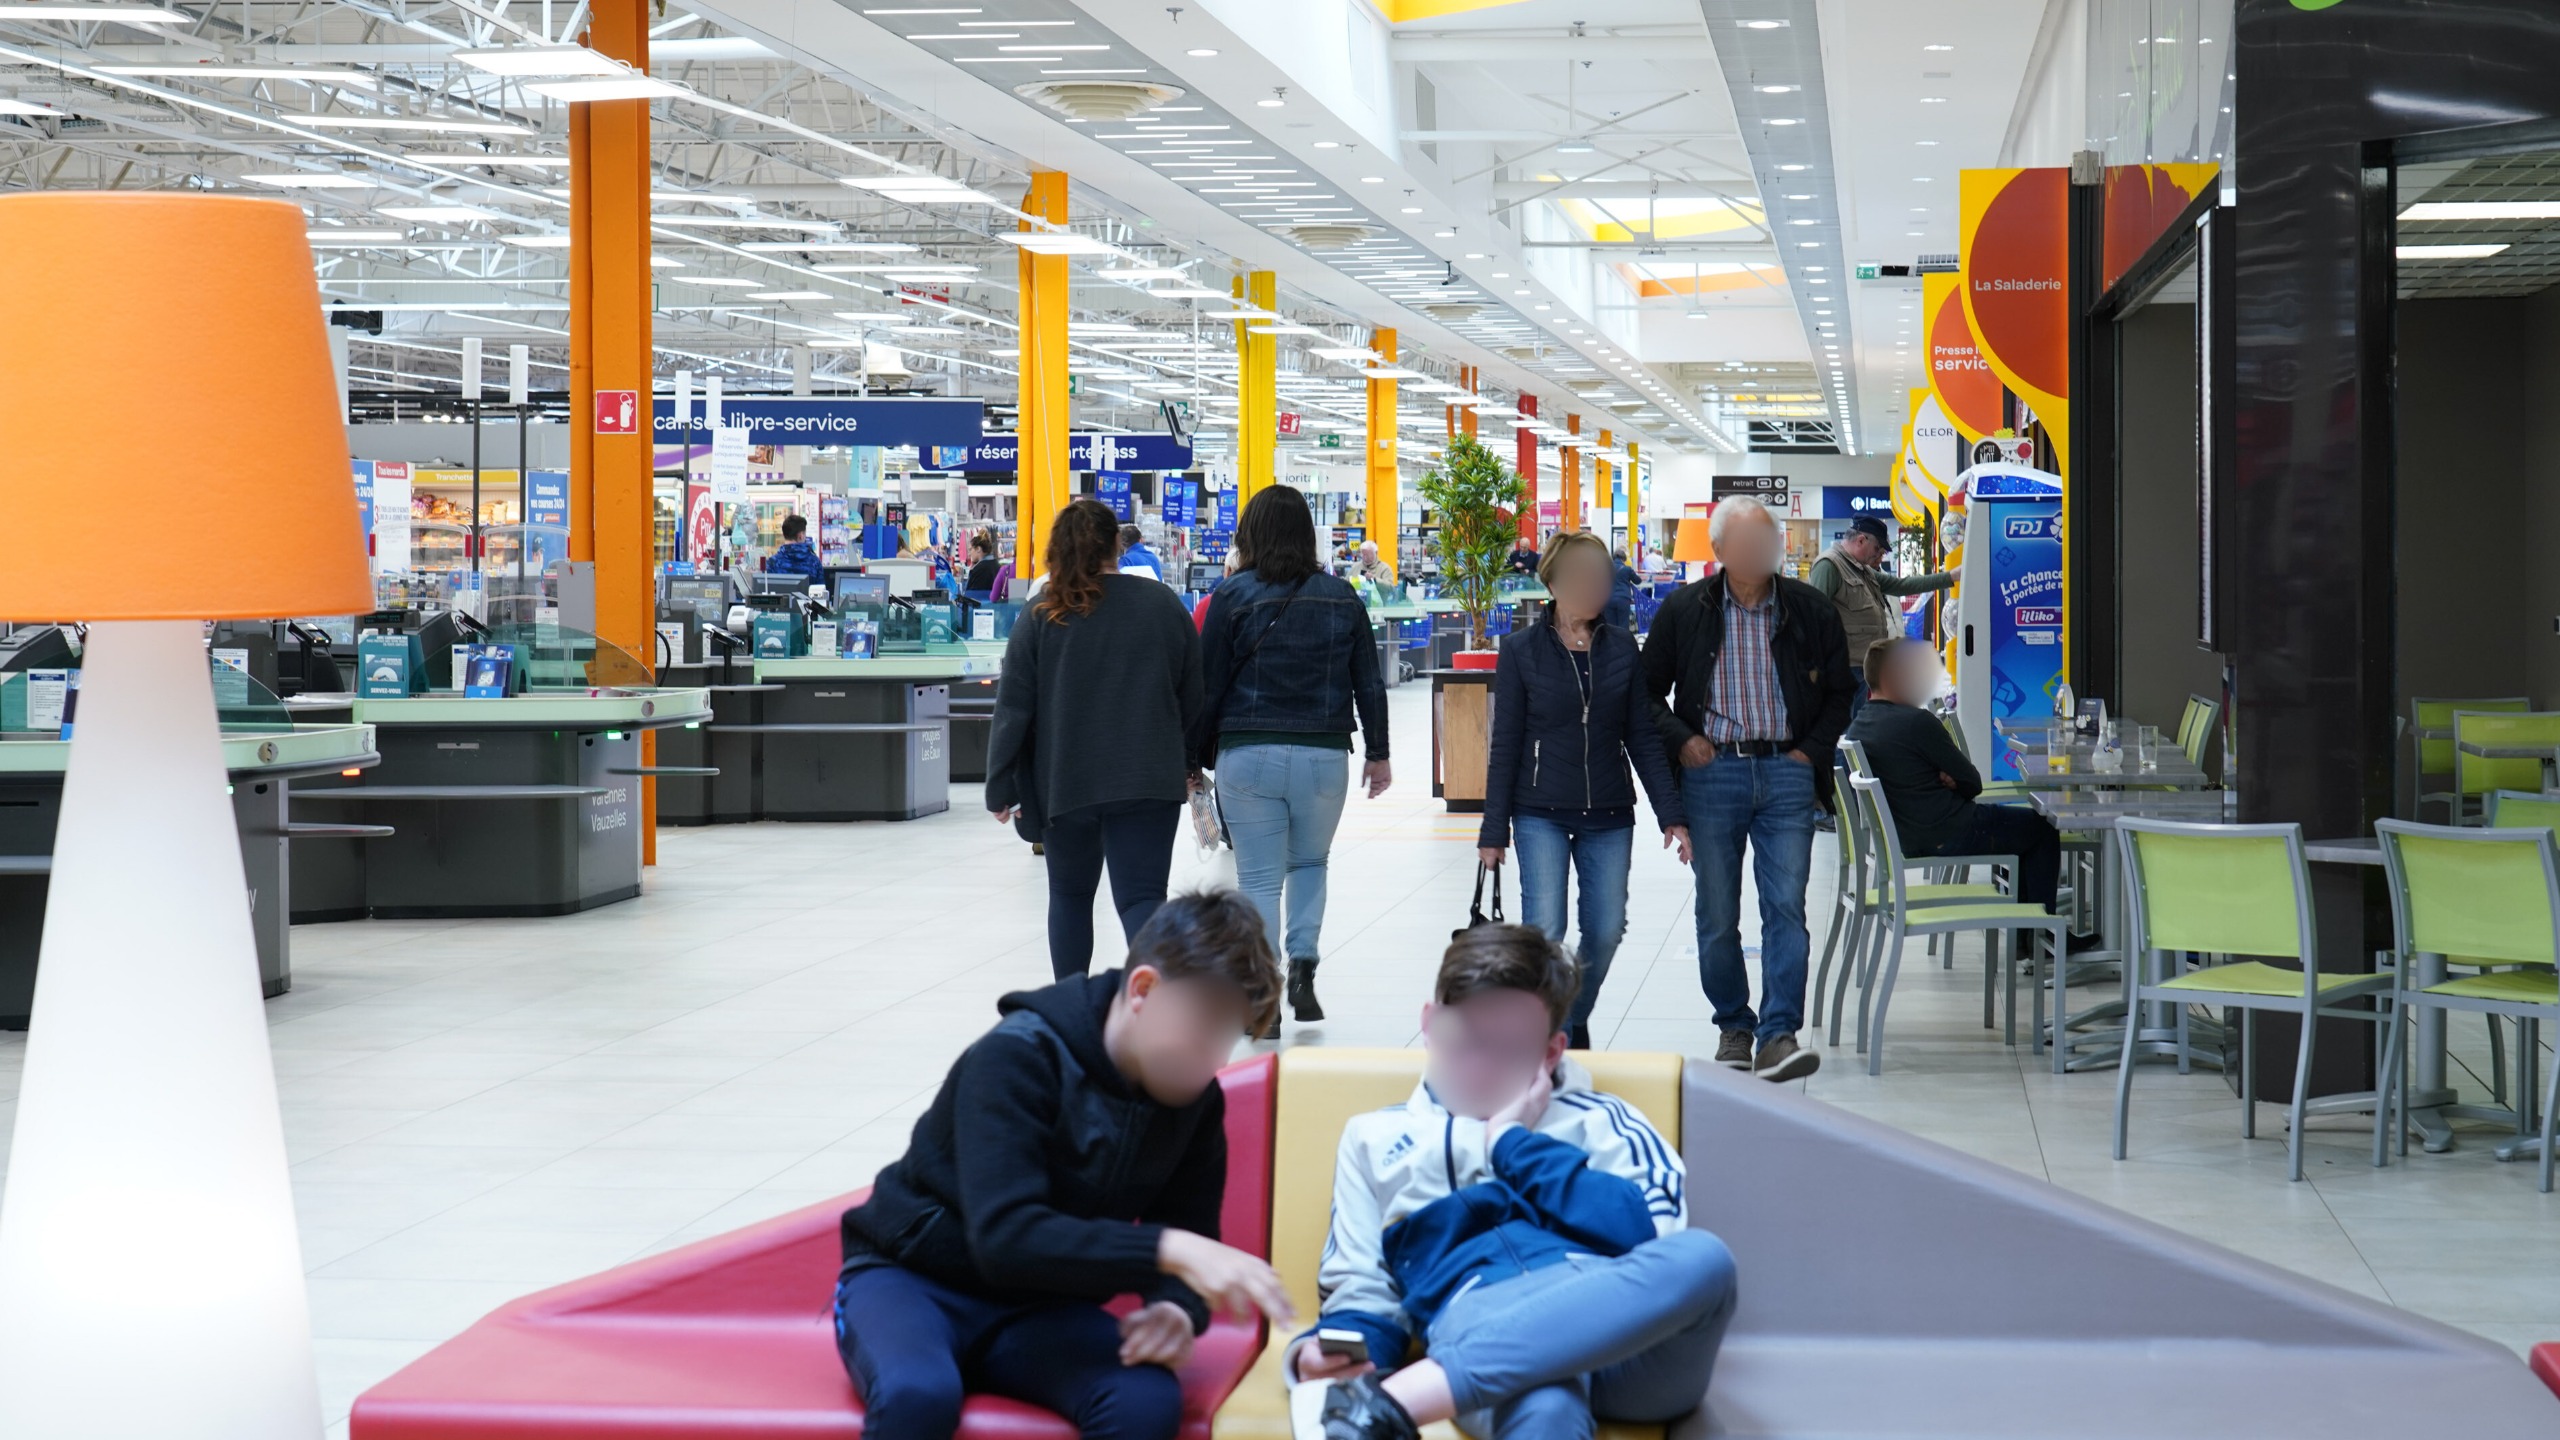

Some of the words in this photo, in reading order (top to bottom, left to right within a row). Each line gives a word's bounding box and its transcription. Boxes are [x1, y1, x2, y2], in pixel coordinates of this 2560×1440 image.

[1975, 280, 1991, 291] La
[1994, 278, 2062, 291] Saladerie
[1934, 345, 1974, 355] Presse
[1935, 356, 1989, 371] servic
[730, 411, 857, 431] libre-service
[1917, 427, 1954, 437] CLEOR
[1870, 497, 1892, 509] Ban
[2009, 520, 2043, 535] FDJ
[2000, 579, 2019, 596] La
[2020, 570, 2063, 587] chance
[2005, 595, 2012, 606] à
[2012, 582, 2044, 604] portée
[2044, 581, 2056, 591] de
[2021, 610, 2055, 624] illiko
[370, 687, 402, 695] SERVEZ-VOUS
[591, 808, 627, 833] Vauzelles
